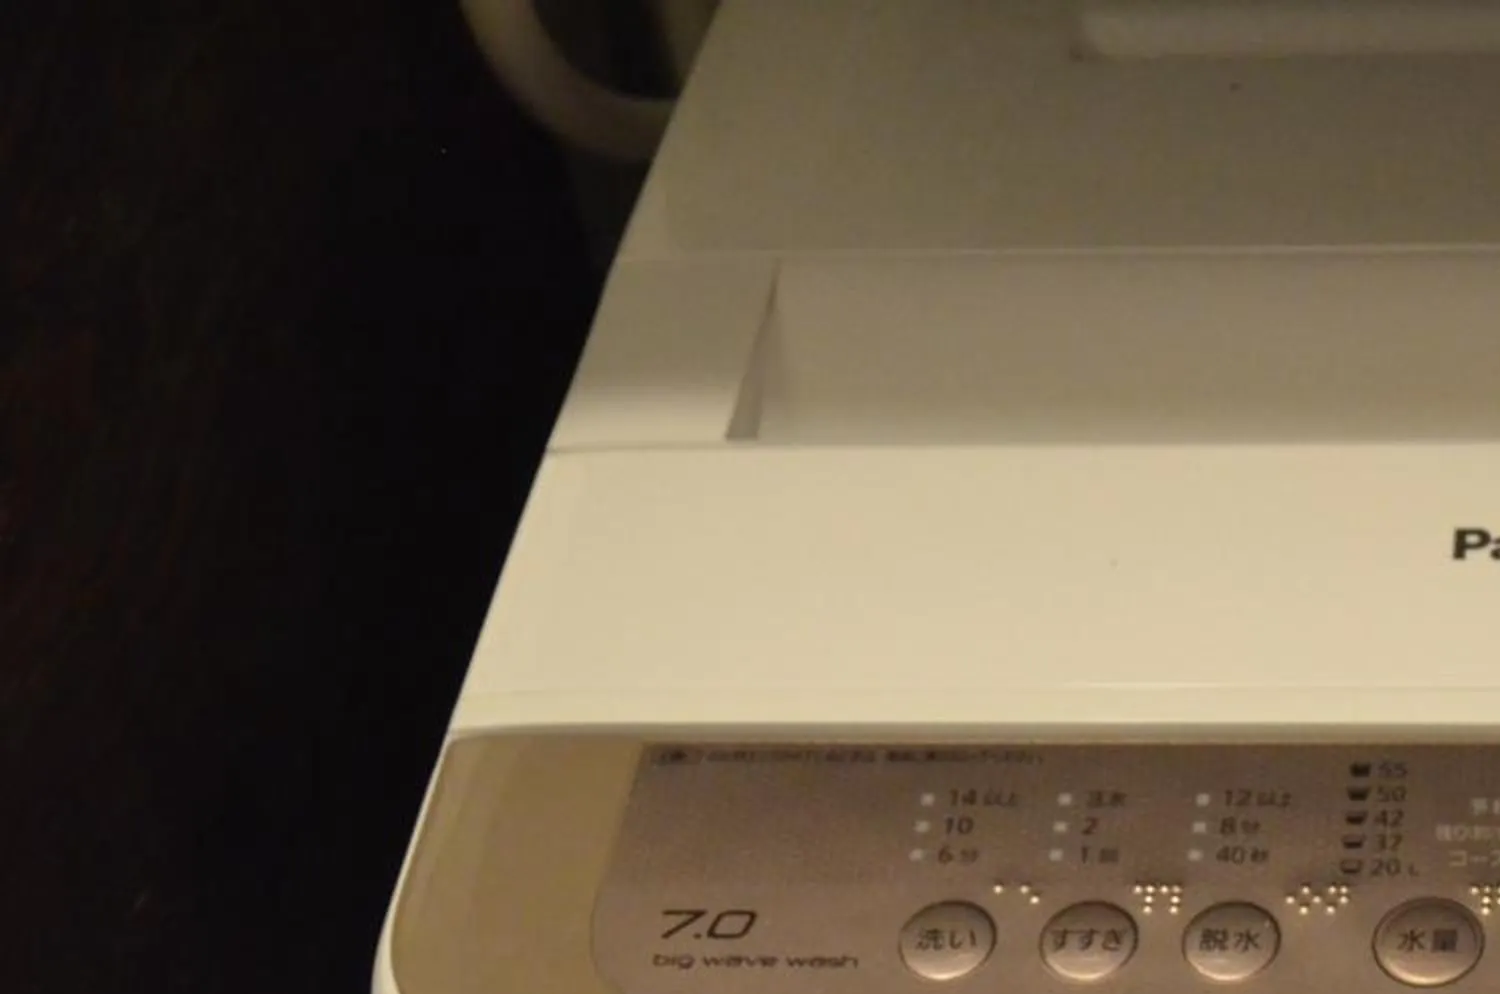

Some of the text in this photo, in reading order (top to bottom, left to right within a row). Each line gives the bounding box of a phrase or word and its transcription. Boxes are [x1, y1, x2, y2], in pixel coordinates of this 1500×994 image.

[944, 816, 976, 836] 10
[1080, 816, 1100, 836] 2
[660, 911, 757, 939] 7.0
[915, 928, 977, 951] 洗い
[1051, 928, 1125, 951] すすぎ
[1200, 928, 1260, 953] 脱水
[1397, 927, 1459, 954] 水量
[787, 955, 858, 968] wash
